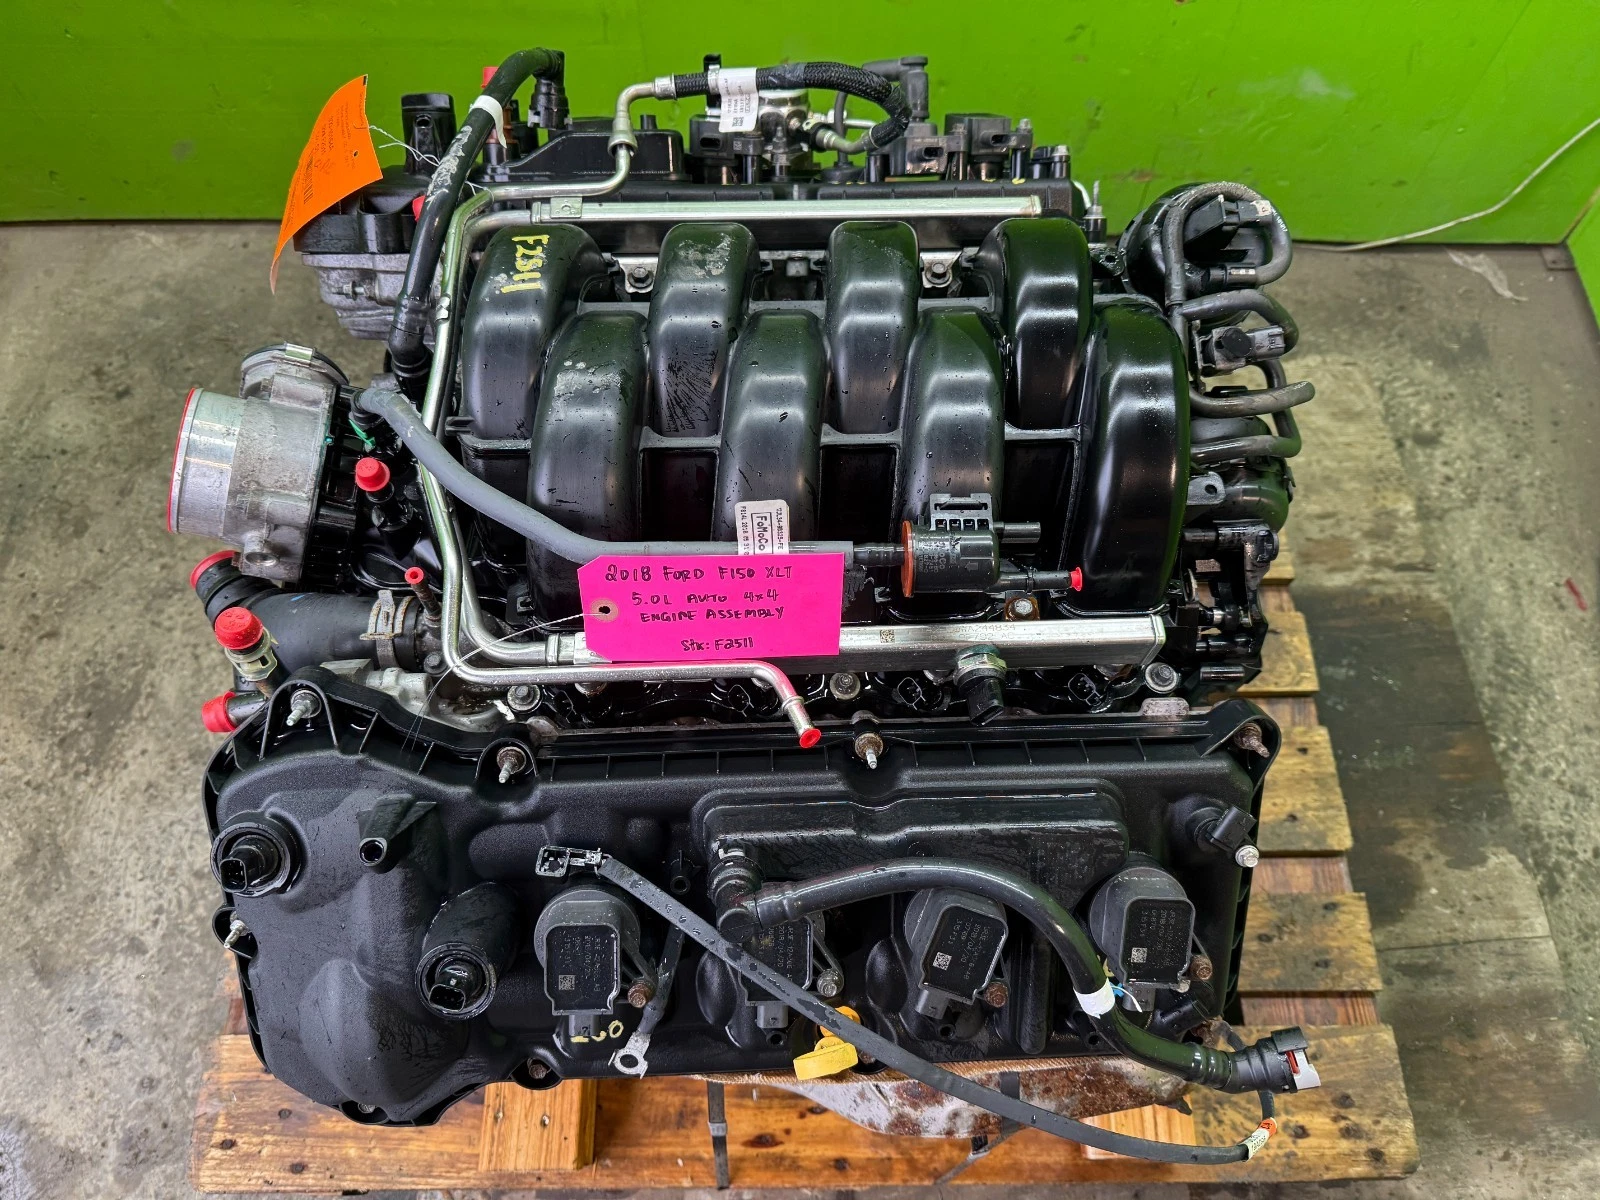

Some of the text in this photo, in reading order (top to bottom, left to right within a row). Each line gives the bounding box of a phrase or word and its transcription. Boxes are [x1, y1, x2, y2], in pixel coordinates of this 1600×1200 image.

[500, 234, 550, 293] F2511
[756, 515, 769, 551] FoMoCo
[605, 563, 793, 582] 2018 FORD F150 XLT
[631, 591, 672, 606] 5.0L
[687, 592, 728, 604] AUTO
[640, 606, 785, 623] ENGINE ASSEMBLY
[714, 636, 754, 651] F2511
